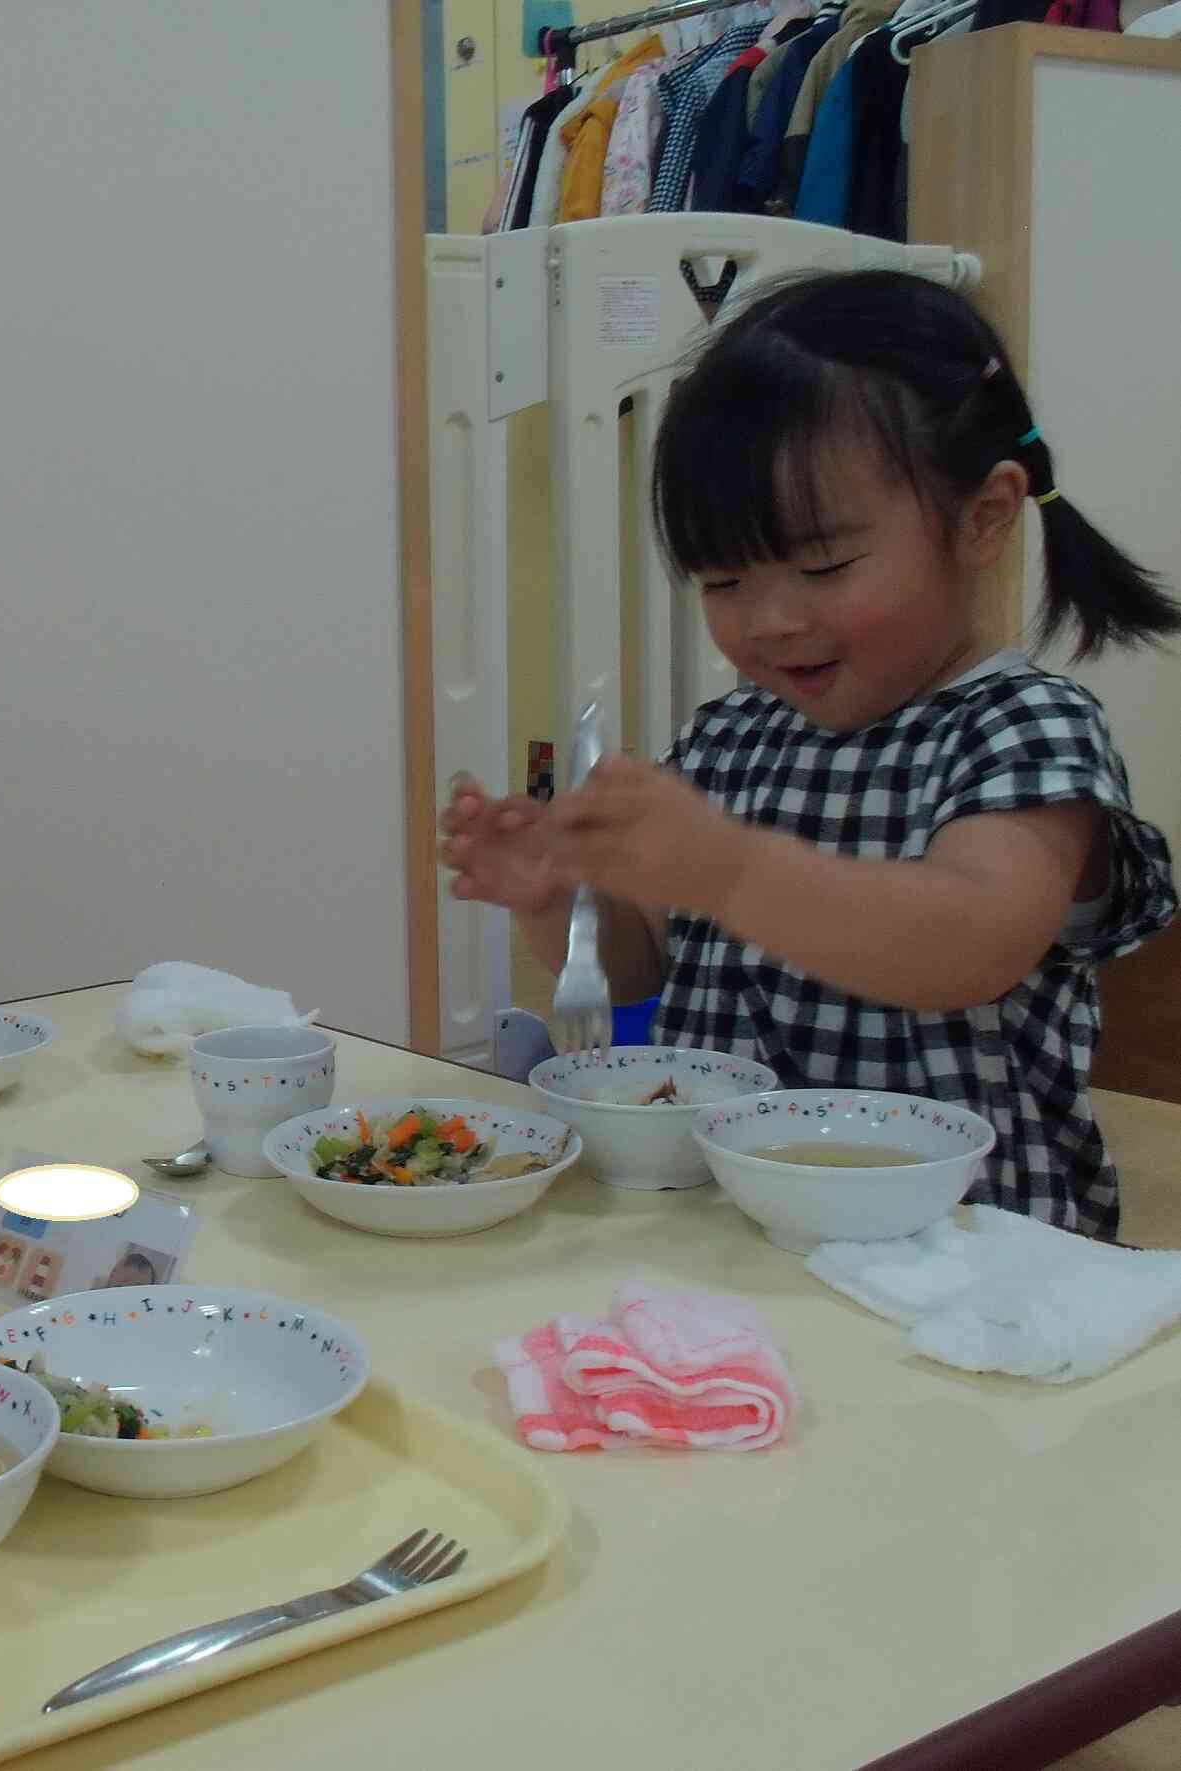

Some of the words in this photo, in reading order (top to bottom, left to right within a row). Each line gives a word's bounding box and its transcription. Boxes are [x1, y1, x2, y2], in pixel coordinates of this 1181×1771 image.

[227, 1079, 237, 1092] S
[757, 1102, 770, 1115] Q
[817, 1105, 828, 1118] S
[909, 1103, 919, 1116] V
[7, 1328, 18, 1344] E
[103, 1311, 117, 1326] H
[140, 1297, 154, 1313] I
[181, 1299, 194, 1314] J
[223, 1306, 234, 1322] K
